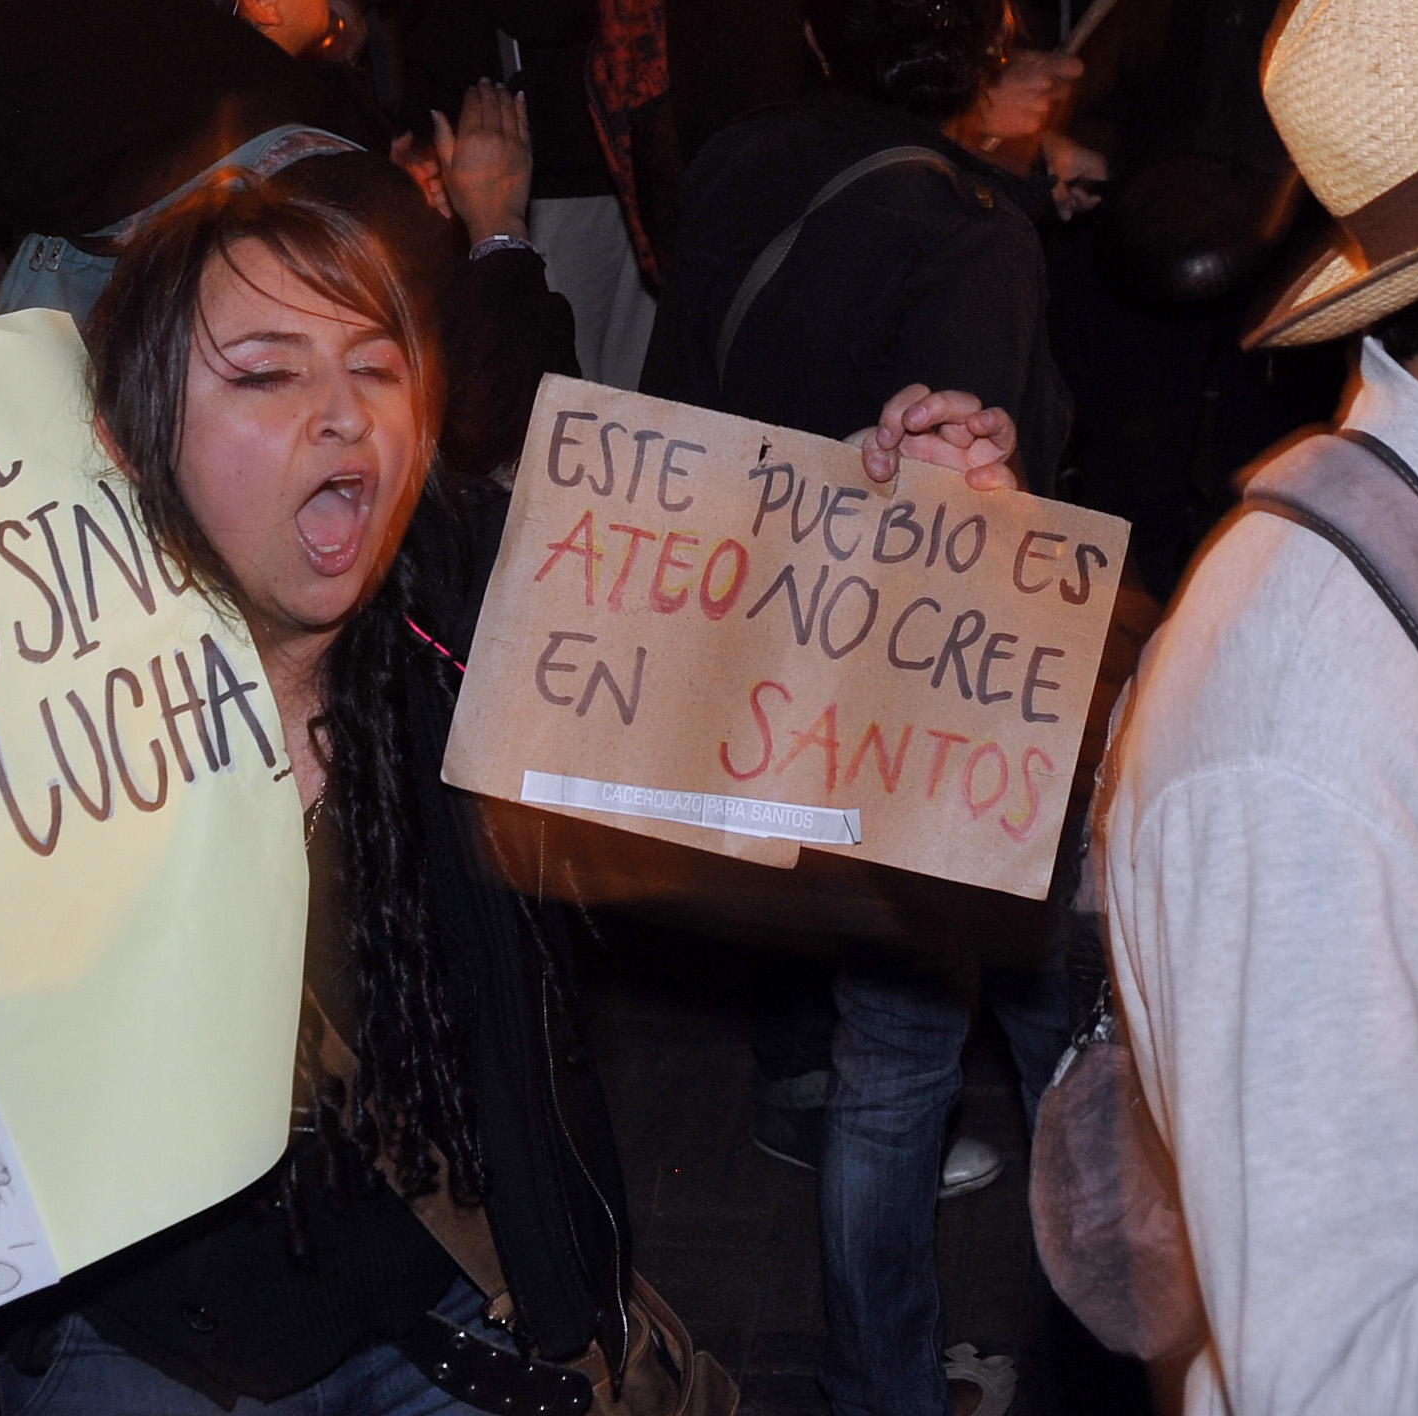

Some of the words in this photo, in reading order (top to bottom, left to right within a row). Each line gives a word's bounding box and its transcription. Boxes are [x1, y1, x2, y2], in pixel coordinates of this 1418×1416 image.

[546, 410, 707, 512] ESTE
[1012, 530, 1108, 605] ES
[534, 509, 750, 621] ATEO
[745, 564, 879, 660] NO
[887, 596, 1065, 724] CREE
[535, 630, 647, 726] EN
[719, 680, 1053, 842] SANTOS
[602, 783, 702, 814] CACEROLAZO
[707, 798, 746, 820] PARA
[750, 804, 814, 830] SANTOS
